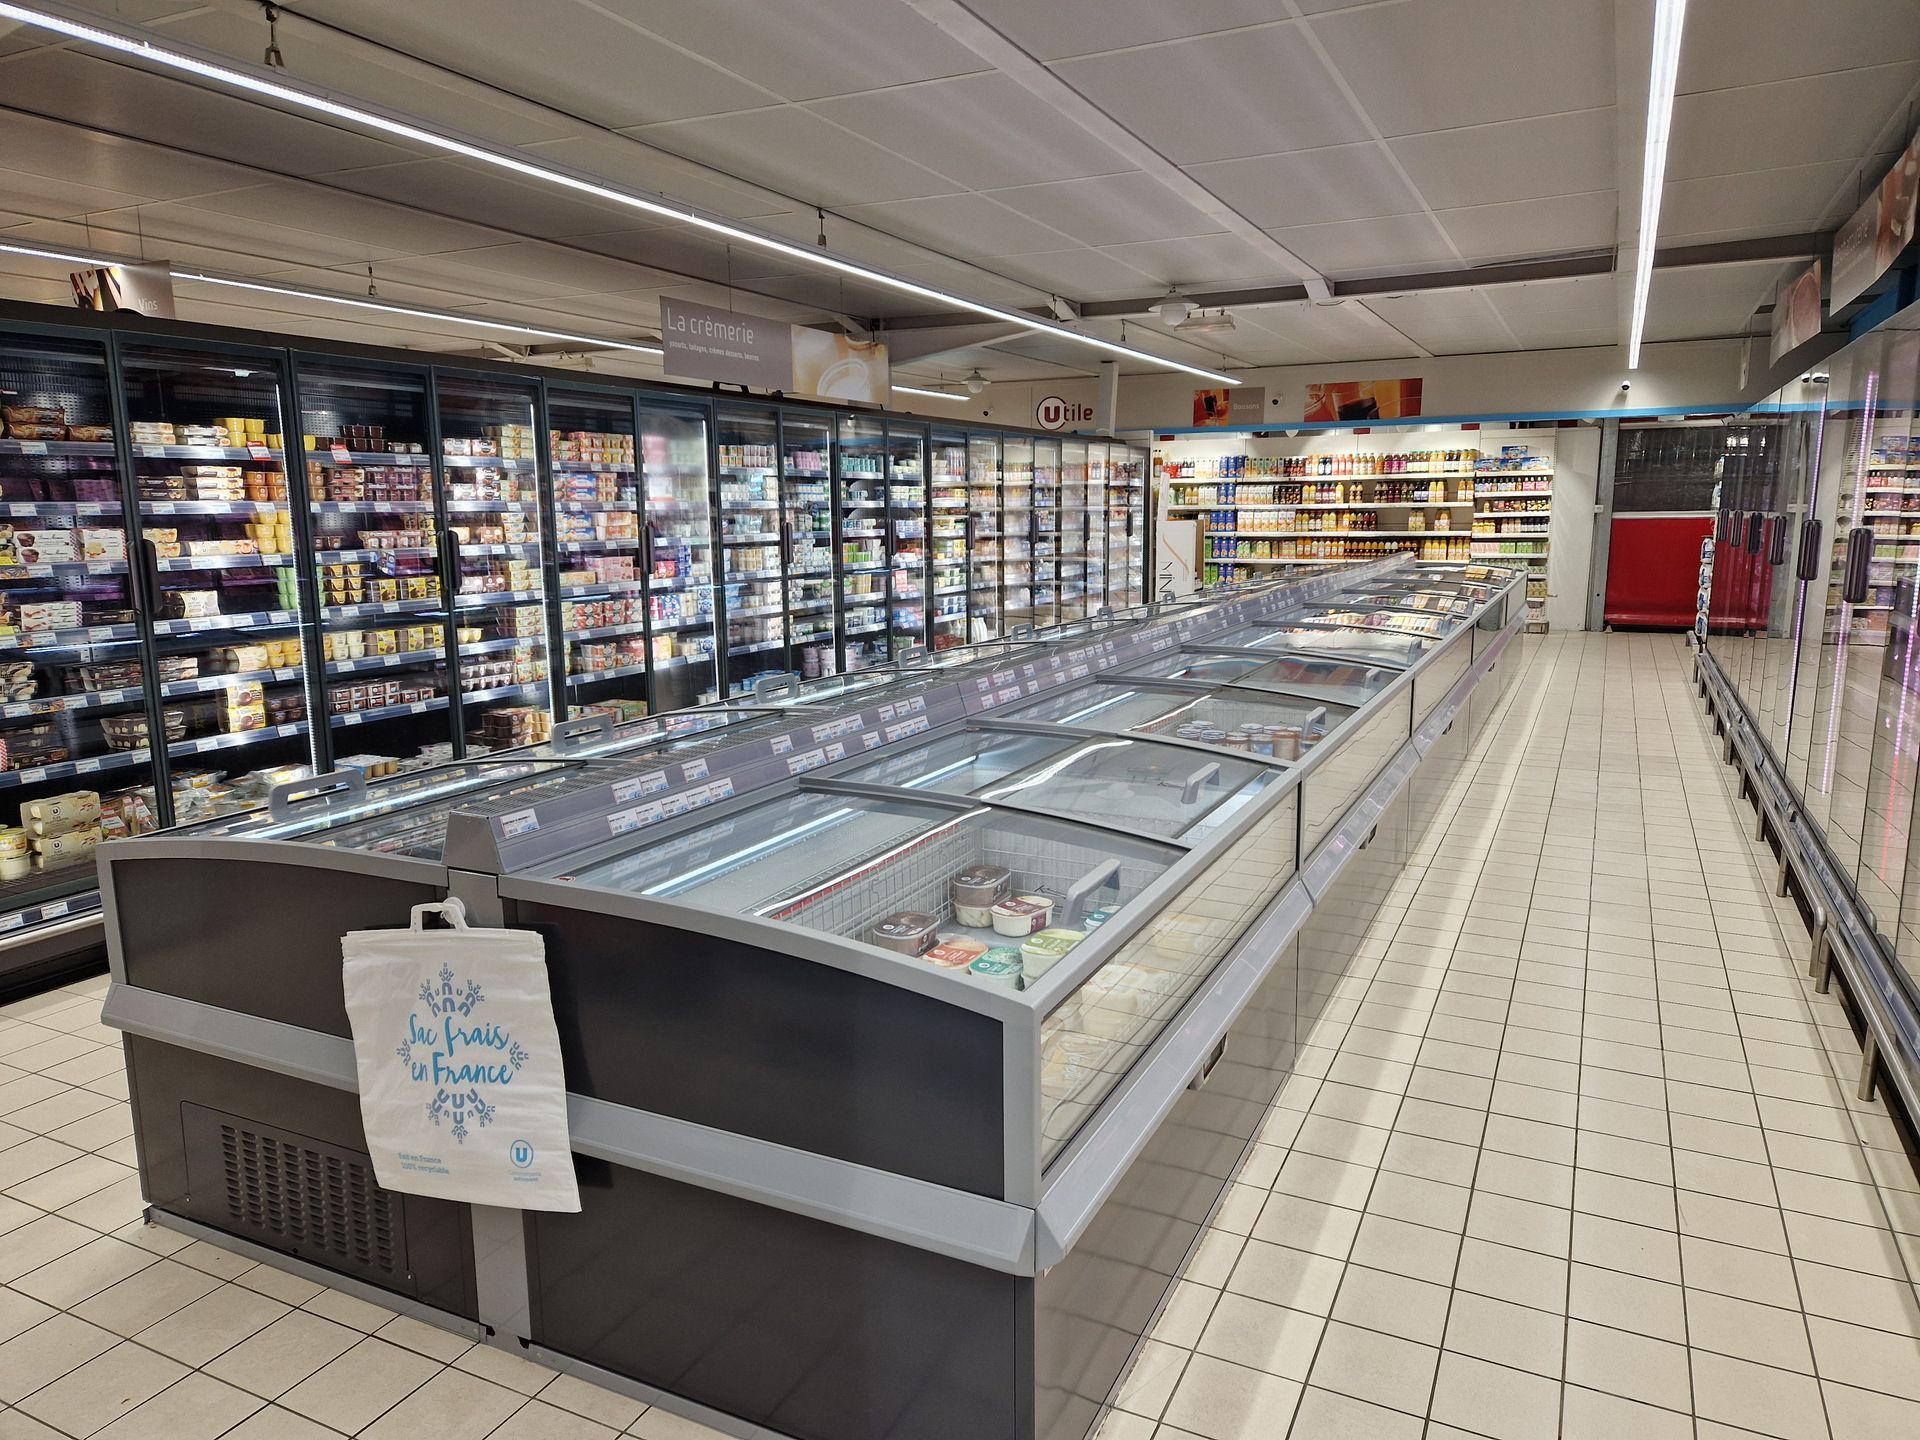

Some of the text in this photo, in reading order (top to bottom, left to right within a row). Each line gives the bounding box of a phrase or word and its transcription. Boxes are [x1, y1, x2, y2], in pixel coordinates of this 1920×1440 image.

[138, 297, 158, 311] Vins
[667, 307, 754, 344] La crèmerie
[1042, 402, 1093, 425] Utile
[409, 1013, 438, 1046] Sac
[411, 1051, 514, 1086] en France
